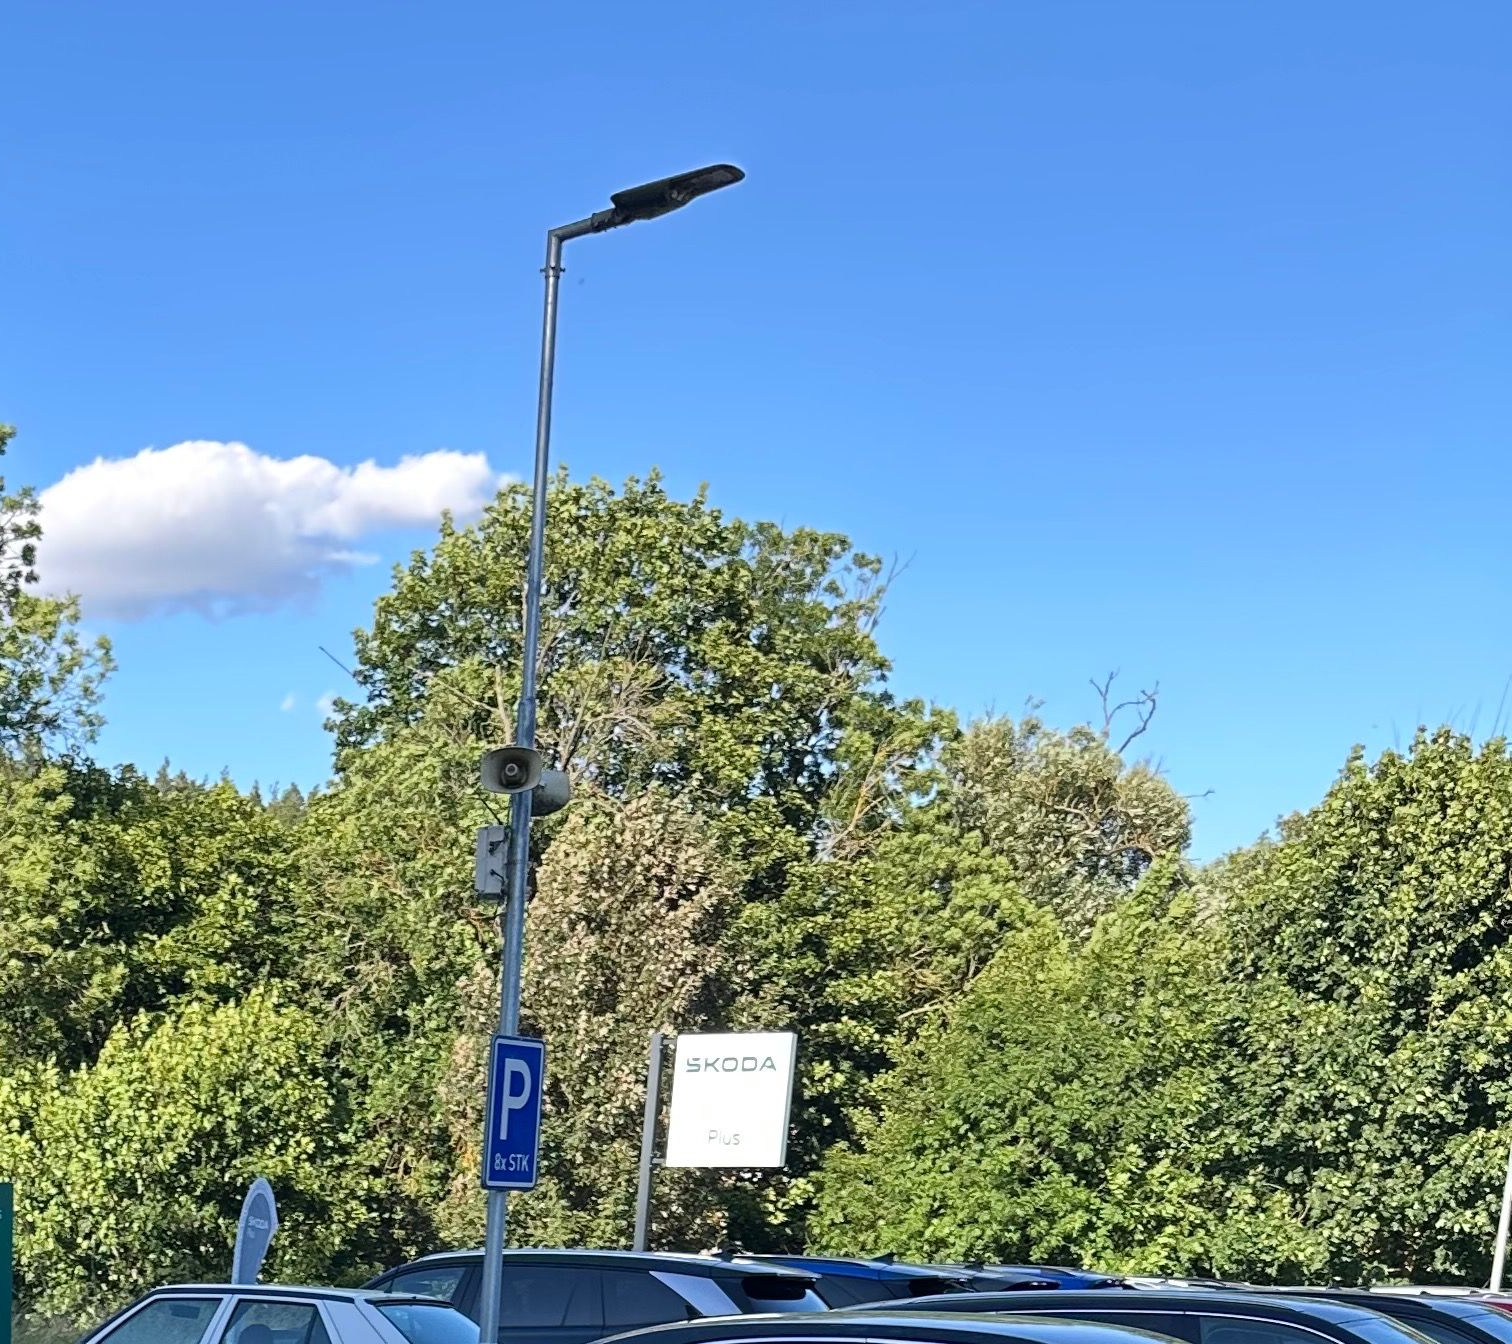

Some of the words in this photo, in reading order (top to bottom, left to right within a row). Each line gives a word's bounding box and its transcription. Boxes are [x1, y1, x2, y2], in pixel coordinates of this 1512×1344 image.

[499, 1058, 532, 1140] P
[707, 1129, 741, 1146] Plus
[494, 1153, 507, 1171] 8x
[508, 1154, 529, 1172] STK
